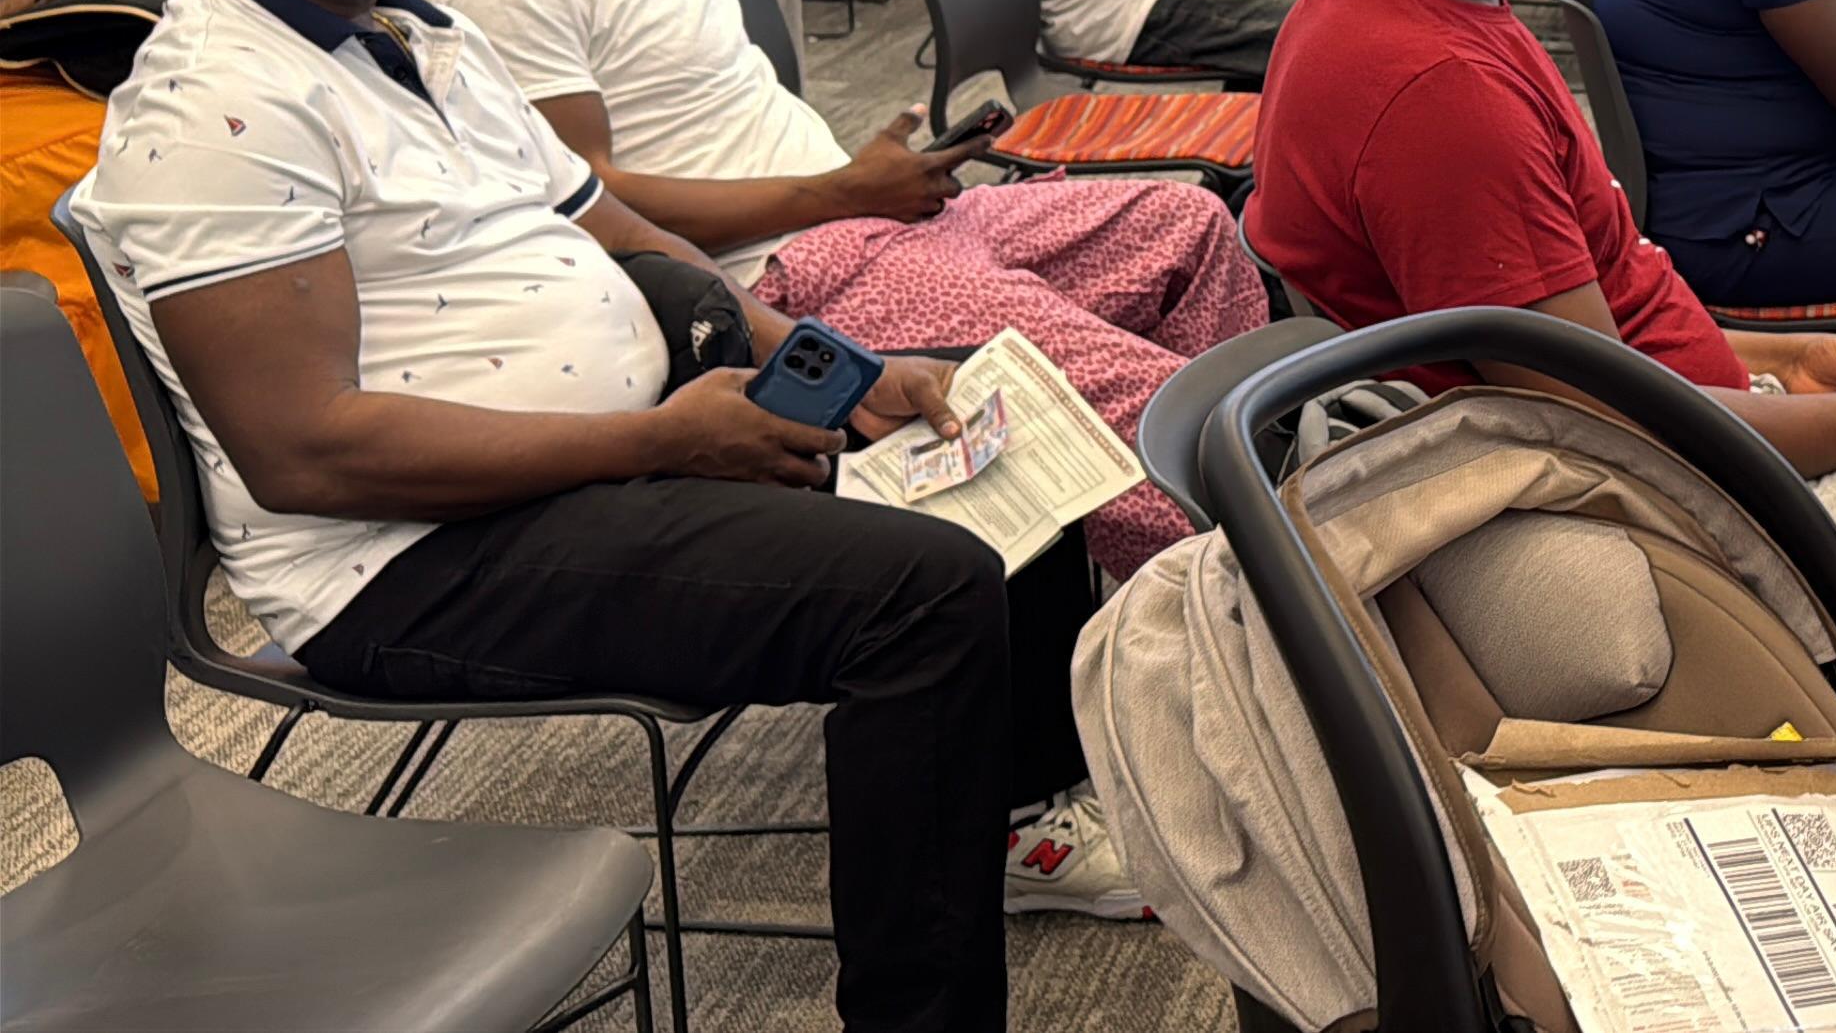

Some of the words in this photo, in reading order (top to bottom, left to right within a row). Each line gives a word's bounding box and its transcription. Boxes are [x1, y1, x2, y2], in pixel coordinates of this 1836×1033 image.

[1021, 838, 1074, 875] N
[1762, 814, 1780, 840] UPS
[1776, 840, 1799, 875] NEXT
[1794, 875, 1815, 900] DAY
[1811, 902, 1827, 928] AIR
